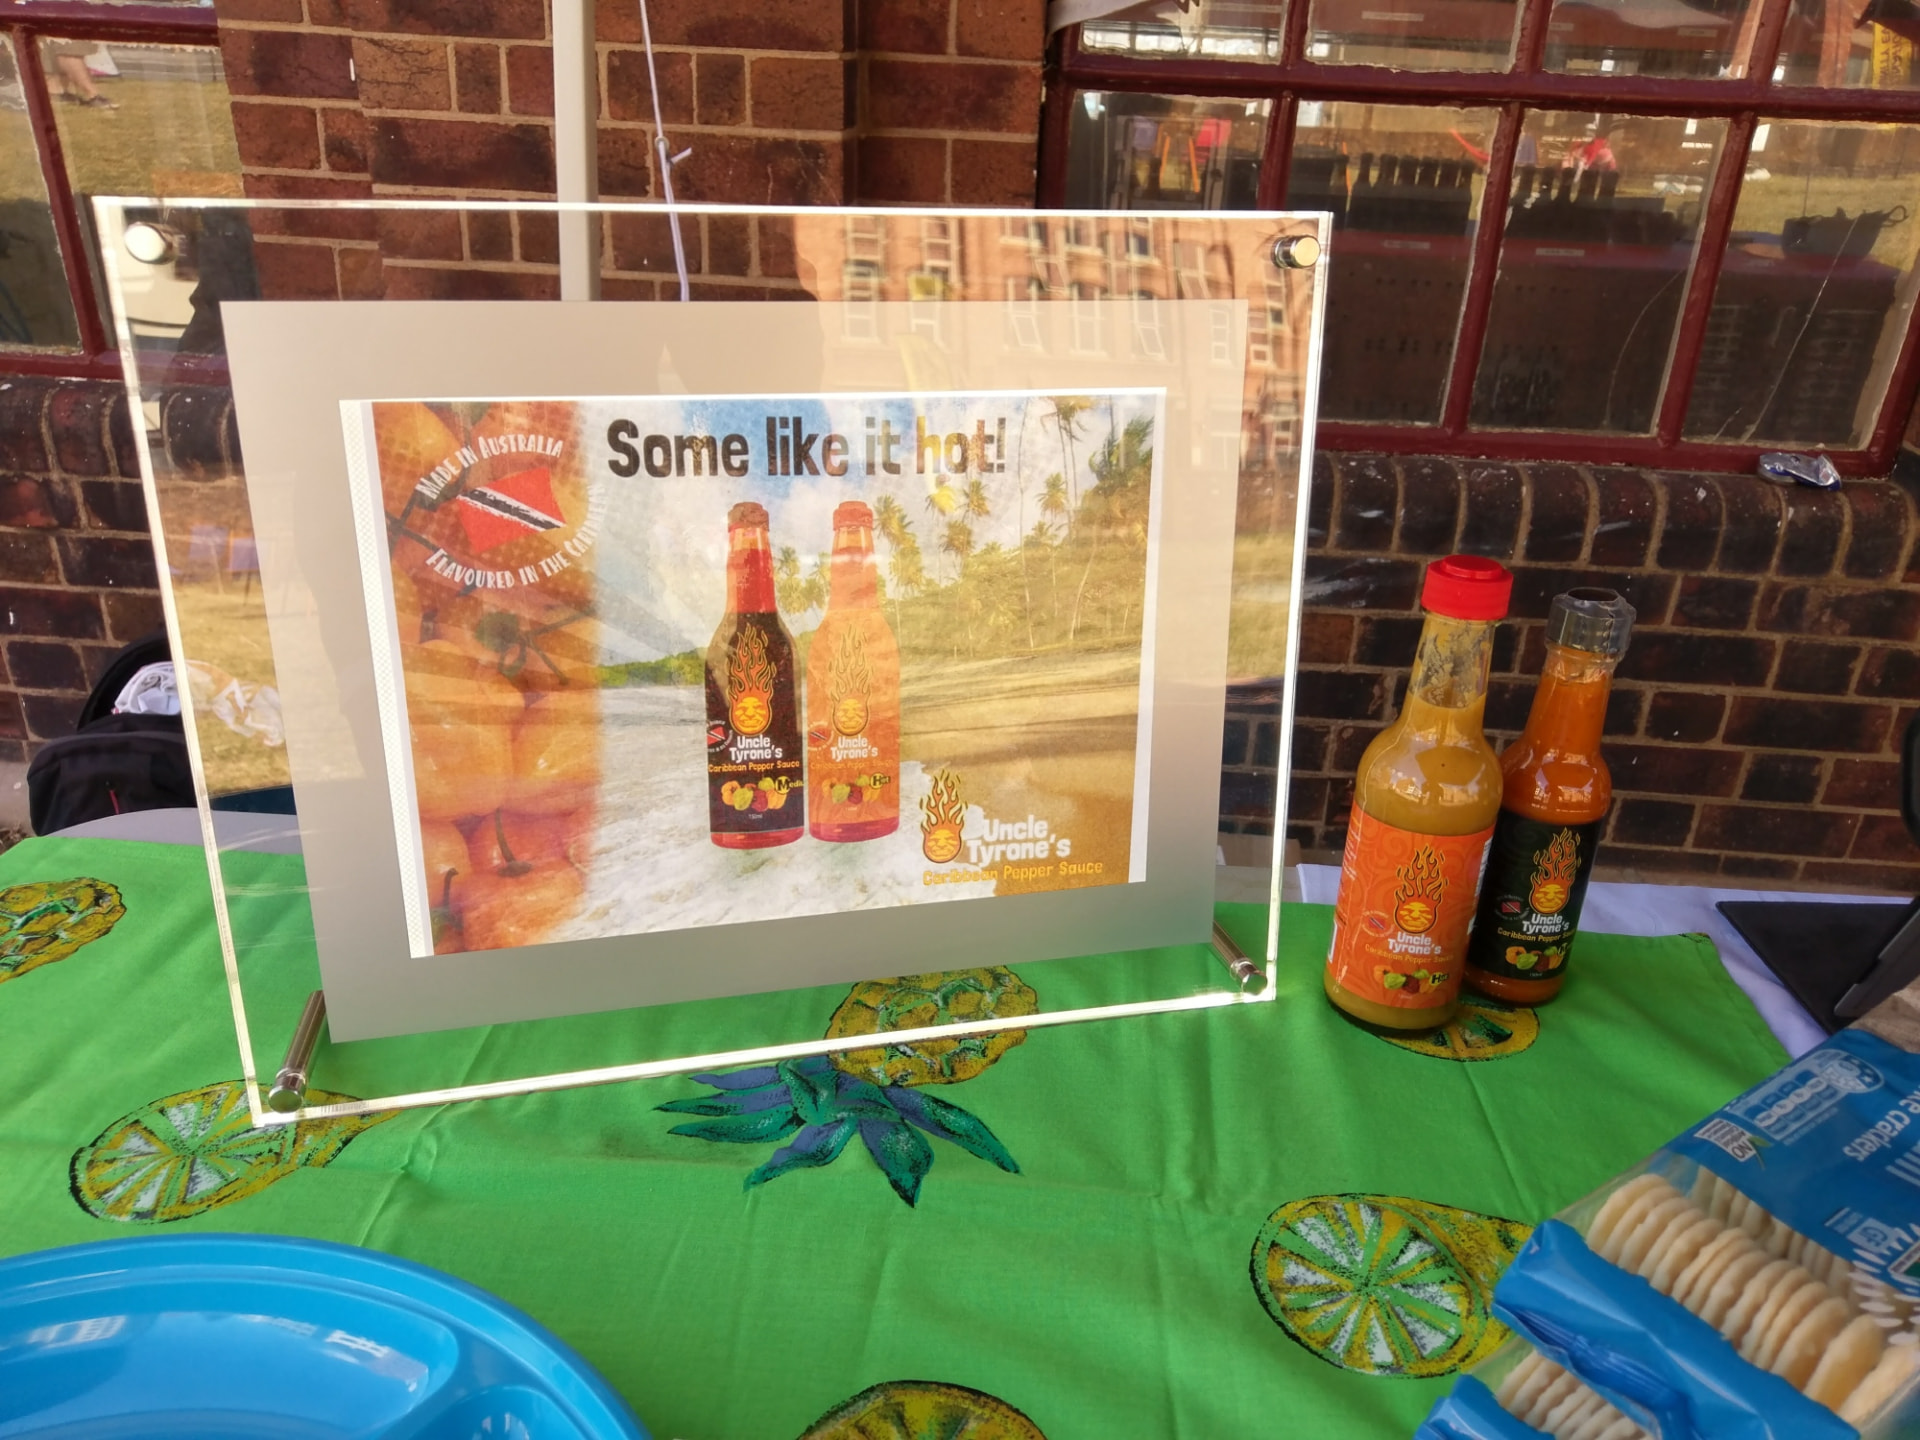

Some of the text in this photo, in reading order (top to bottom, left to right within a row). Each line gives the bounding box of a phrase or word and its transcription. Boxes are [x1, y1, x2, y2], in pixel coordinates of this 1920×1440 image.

[606, 415, 1007, 479] Some like it hot!
[415, 434, 564, 500] MADE IN AUSTRALIA
[425, 548, 516, 589] FLAVOURED
[518, 564, 540, 586] IN
[538, 550, 572, 578] THE
[736, 734, 771, 749] Uncle
[837, 734, 868, 749] Uncle
[729, 745, 783, 763] Tyrone's
[830, 745, 879, 763] Tyrone's
[708, 763, 747, 773] Caribbean
[748, 761, 775, 773] Pepper
[983, 814, 1049, 842] Uncle
[966, 834, 1072, 867] Tyrone's
[922, 861, 1104, 886] Caribbean Pepper Sauce
[1522, 920, 1570, 935] Tyrone's
[1531, 913, 1563, 925] Uncle
[1396, 931, 1432, 945] Uncle
[1497, 926, 1537, 942] Caribbean
[1388, 938, 1442, 955] Tyrone's
[1842, 1110, 1911, 1162] crackers
[1731, 1141, 1753, 1159] NO
